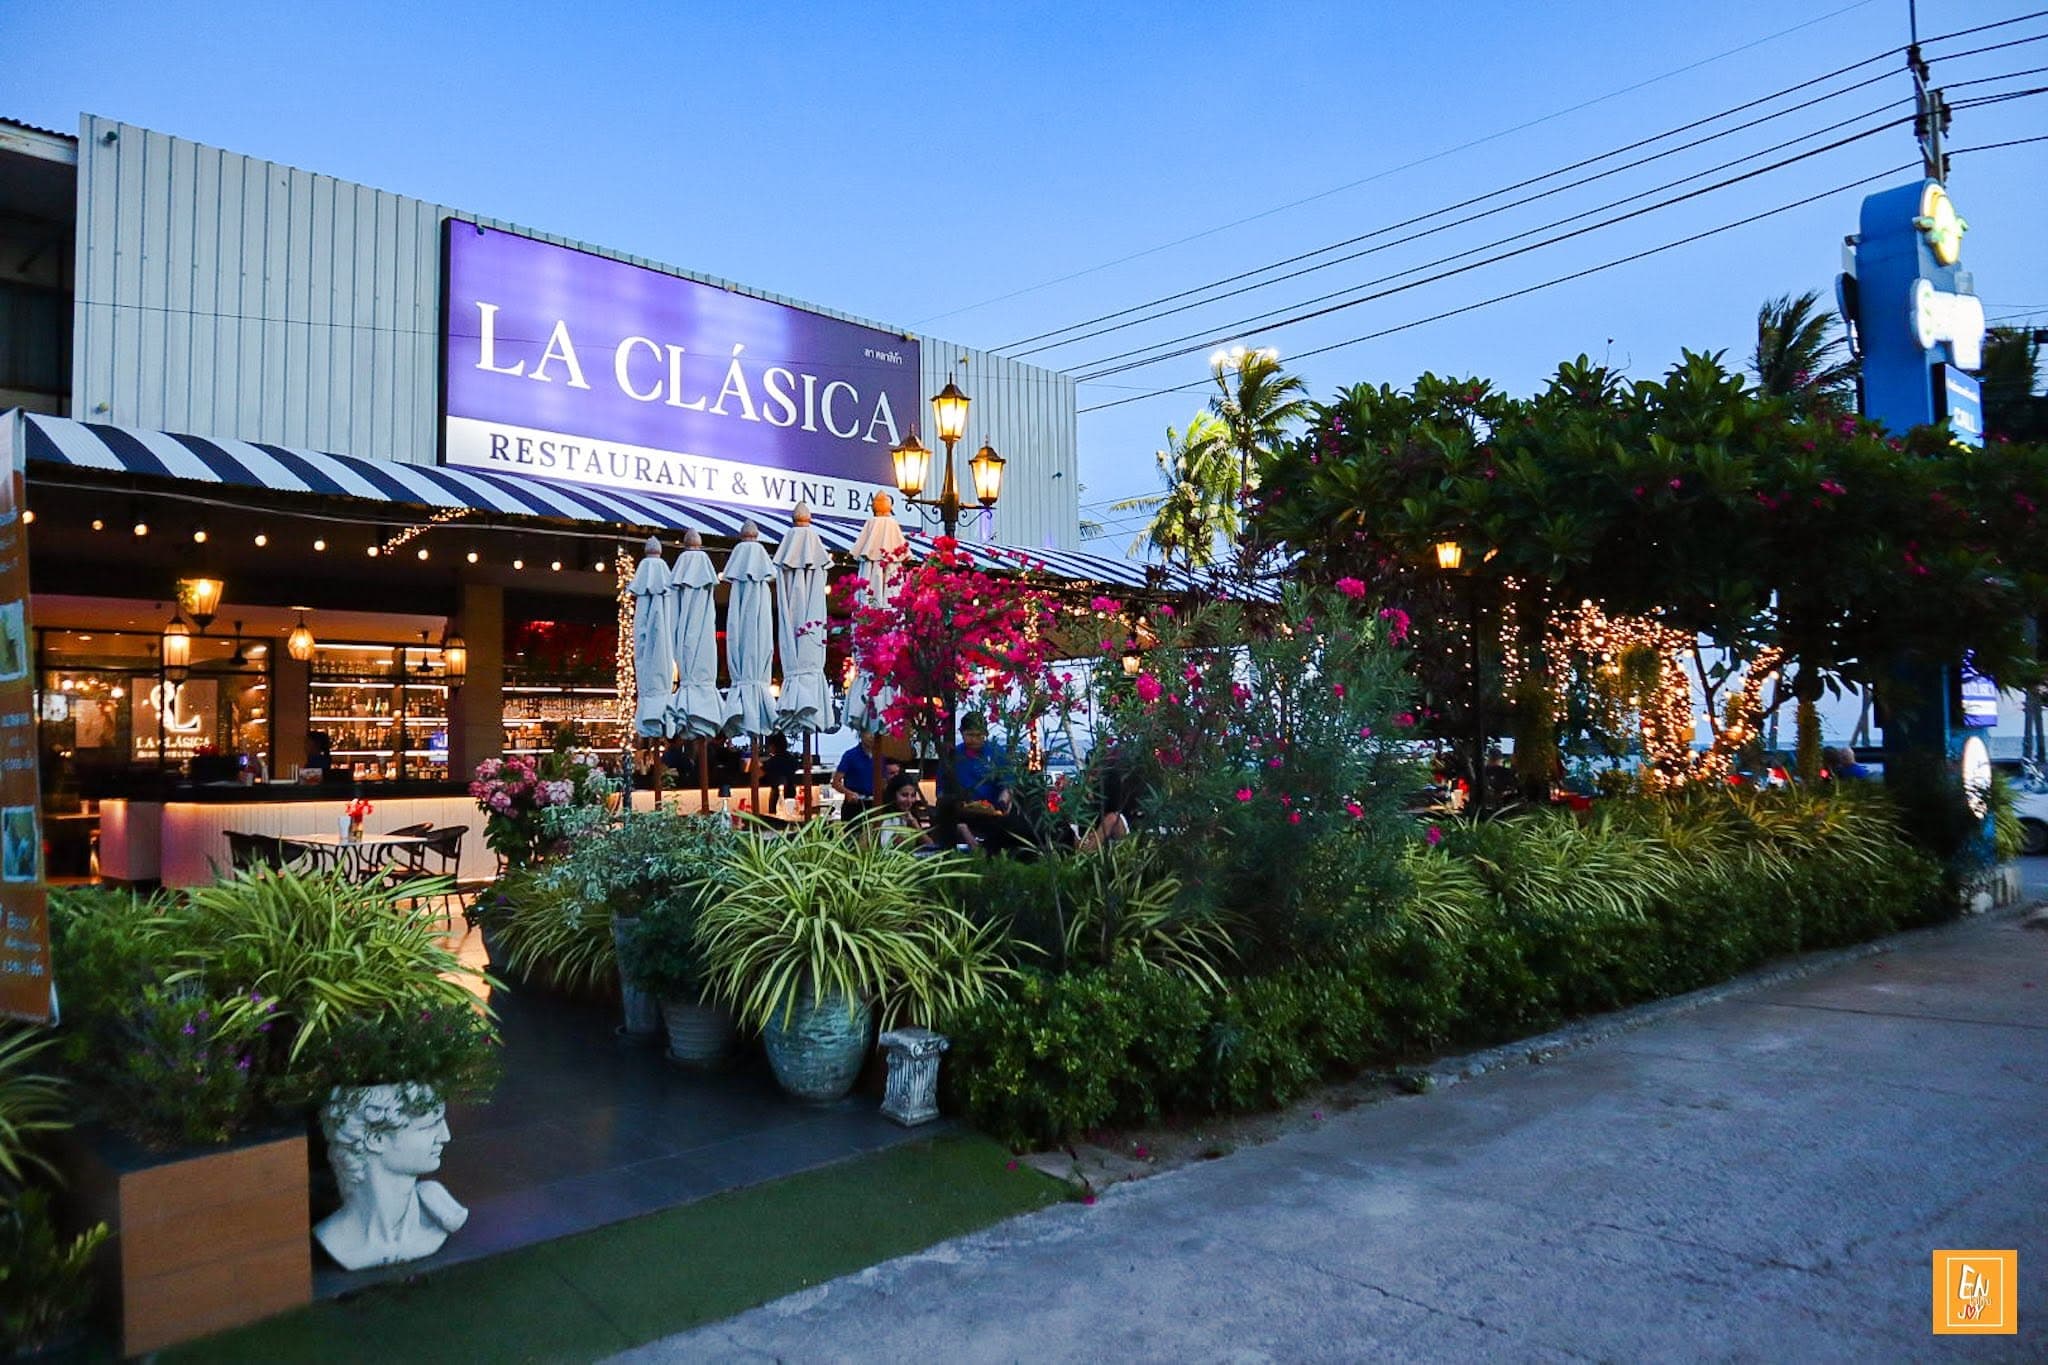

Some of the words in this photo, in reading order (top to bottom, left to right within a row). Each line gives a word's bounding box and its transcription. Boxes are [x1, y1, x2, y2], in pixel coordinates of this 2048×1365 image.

[475, 301, 591, 390] LA
[614, 335, 901, 447] CLÁSICA
[489, 433, 719, 492] RESTAURANT
[731, 473, 750, 496] &
[761, 475, 836, 509] WINE
